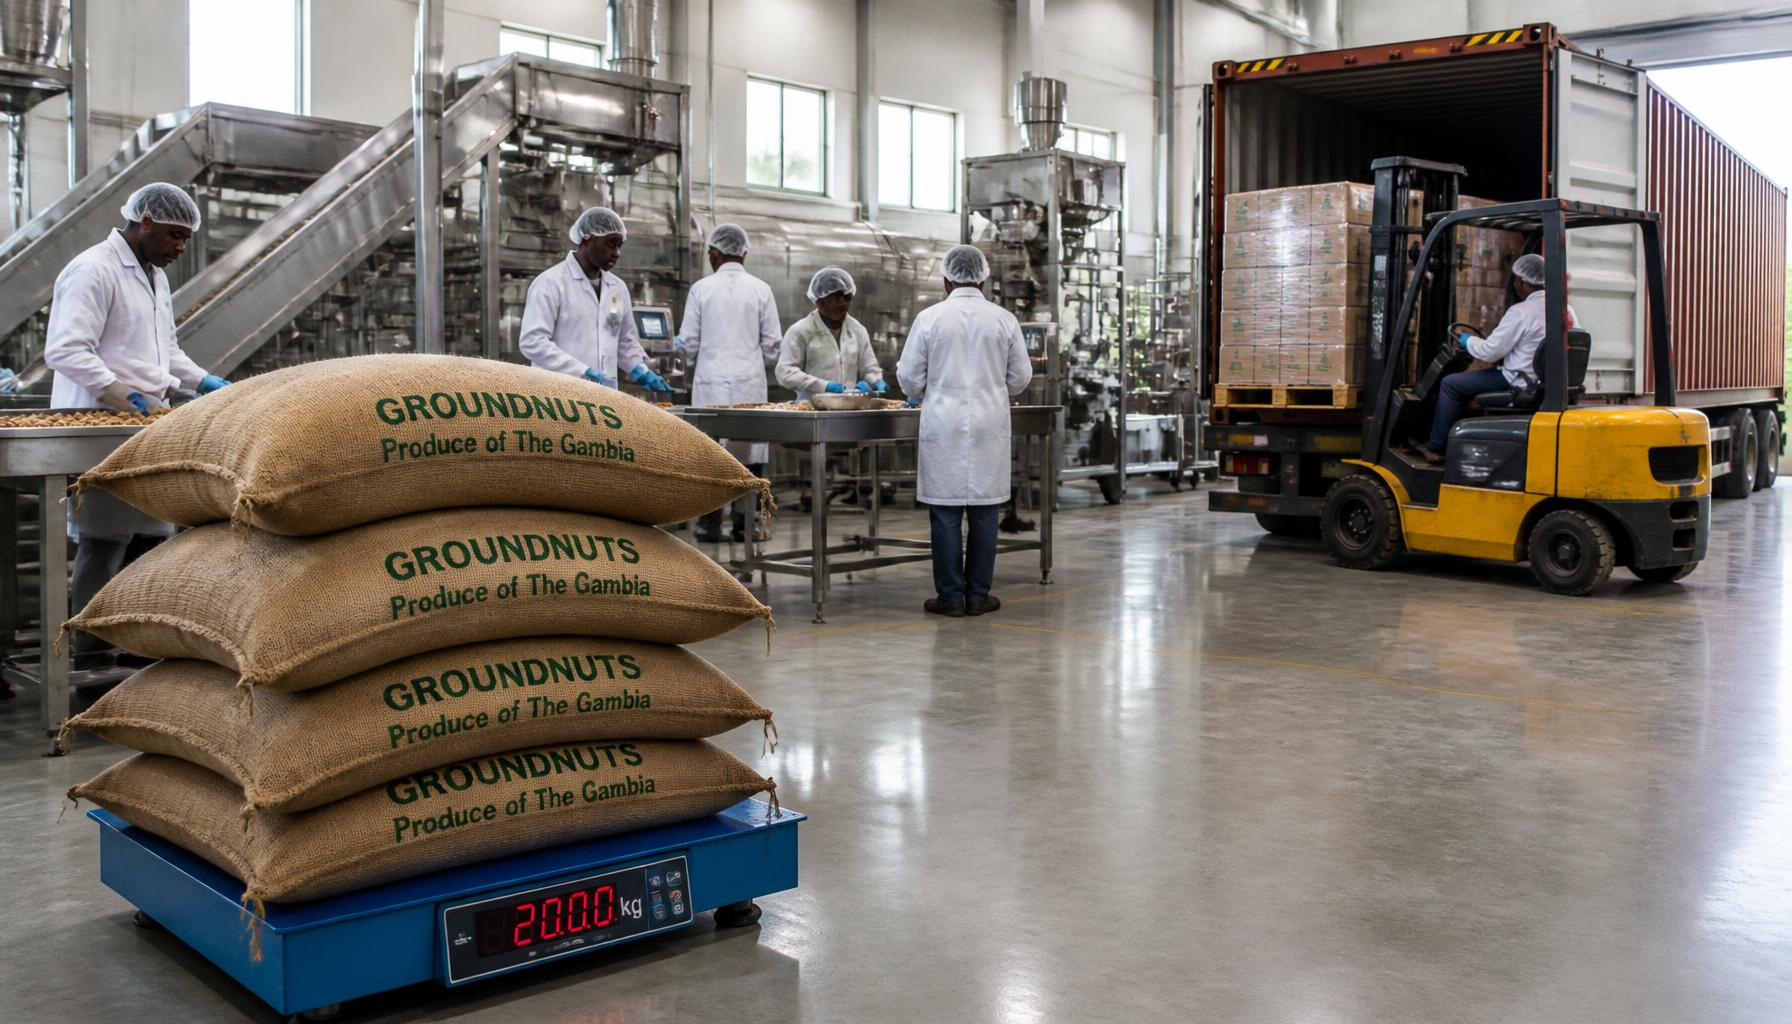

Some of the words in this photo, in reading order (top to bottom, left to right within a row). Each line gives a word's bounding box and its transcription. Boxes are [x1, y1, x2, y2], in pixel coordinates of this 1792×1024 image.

[375, 392, 622, 429] GROUNDNUTS
[381, 433, 477, 463] Produce
[486, 430, 507, 453] of
[512, 430, 554, 454] The
[561, 433, 635, 462] Gambia
[384, 533, 641, 581] GROUNDNUTS
[389, 584, 489, 620] Produce
[496, 575, 519, 599] of
[525, 573, 567, 596] The
[575, 571, 651, 596] Gambia
[383, 654, 642, 711] GROUNDNUTS
[388, 714, 489, 749] Produce
[497, 698, 520, 724] of
[527, 696, 569, 719] The
[576, 689, 651, 713] Gambia
[386, 743, 644, 805] GROUNDNUTS
[392, 803, 497, 844] Produce
[505, 791, 527, 816] of
[533, 786, 574, 811] The
[581, 775, 656, 803] Gambia
[620, 896, 642, 918] kg
